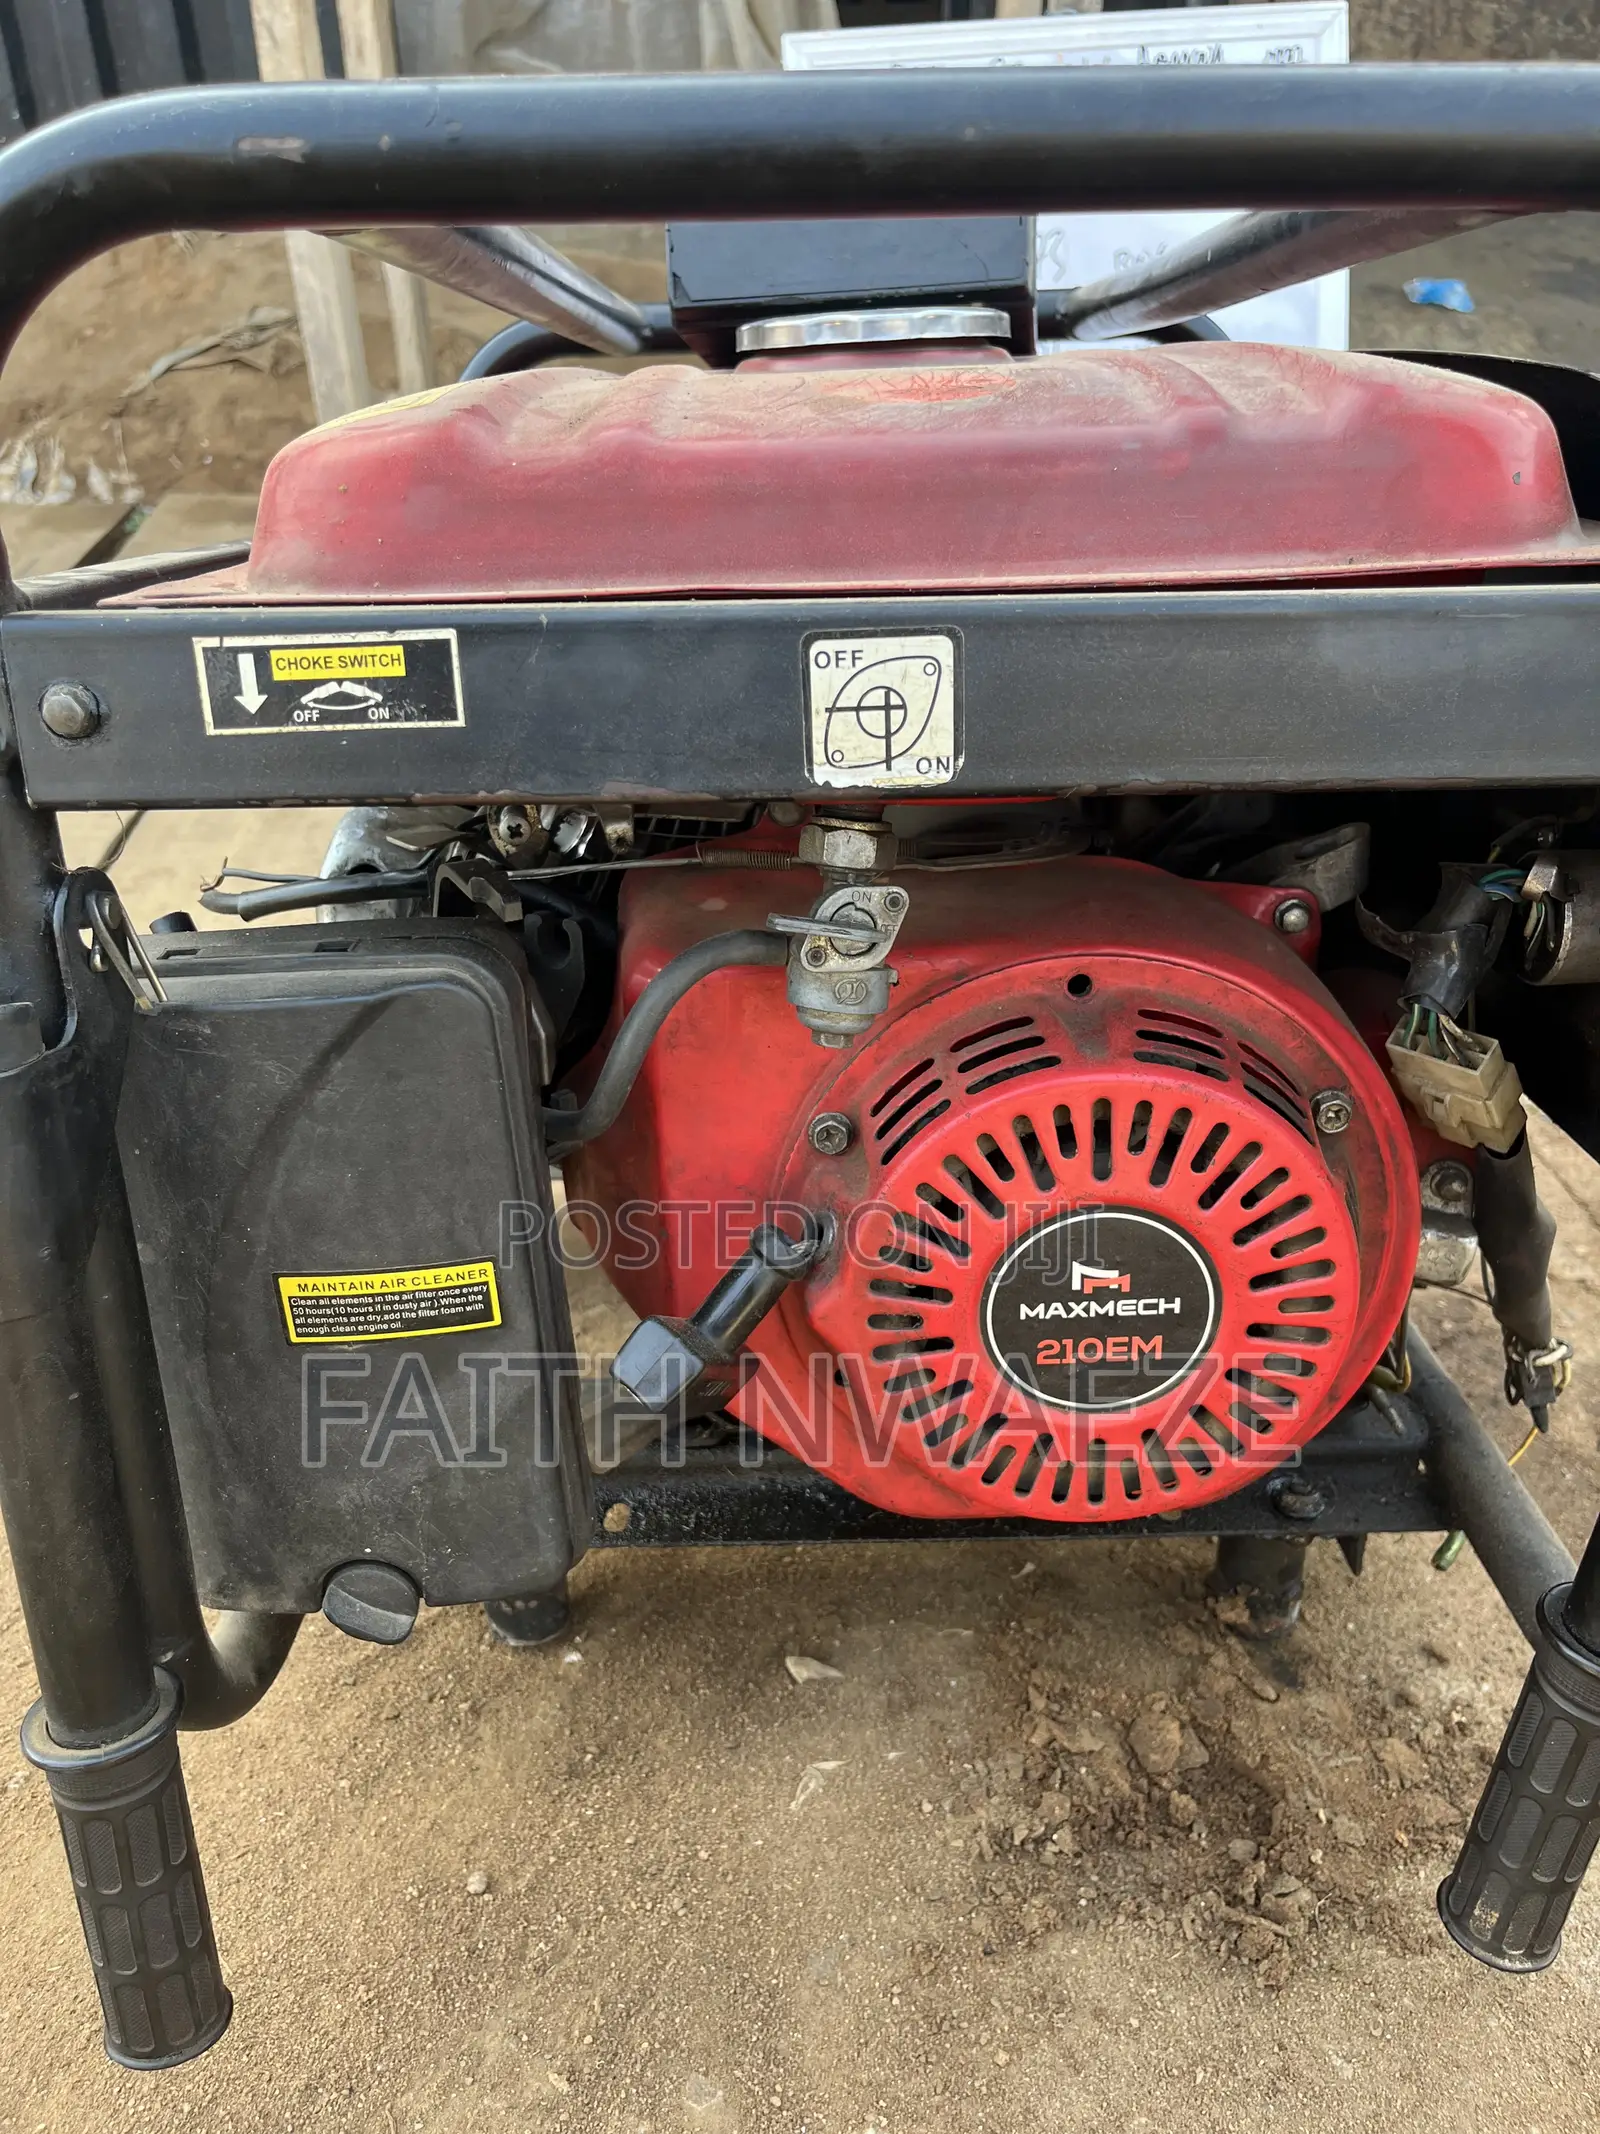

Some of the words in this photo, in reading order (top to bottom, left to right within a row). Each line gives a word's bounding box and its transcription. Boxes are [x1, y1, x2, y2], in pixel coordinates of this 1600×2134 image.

[275, 656, 334, 671] CHOKE
[338, 653, 402, 669] SWITCH
[814, 650, 864, 669] OFF
[293, 710, 320, 723] OFF
[367, 706, 390, 720] ON
[916, 756, 950, 774] ON
[851, 890, 872, 903] ON
[297, 1280, 375, 1293] MAINTAIN
[379, 1278, 406, 1289] AIR
[411, 1268, 489, 1286] CLEANER
[290, 1297, 318, 1306] Clean
[318, 1296, 330, 1305] all
[331, 1294, 373, 1305] elements
[374, 1294, 384, 1303] in
[384, 1292, 400, 1302] the
[401, 1291, 414, 1301] air
[415, 1289, 437, 1299] filter
[438, 1287, 461, 1298] once
[462, 1284, 488, 1294] every
[292, 1306, 304, 1315] 50
[347, 1303, 373, 1313] hours
[375, 1303, 382, 1312] if
[382, 1302, 392, 1311] in
[393, 1300, 418, 1311] dusty
[419, 1299, 432, 1308] air
[467, 1294, 484, 1303] the
[294, 1316, 306, 1325] all
[306, 1314, 349, 1325] elements
[349, 1314, 365, 1323] are
[402, 1308, 417, 1319] the
[418, 1307, 440, 1318] filter
[440, 1305, 465, 1315] foam
[465, 1303, 485, 1312] with
[1019, 1297, 1181, 1321] MAXMECH
[296, 1324, 330, 1335] enough
[331, 1322, 357, 1333] clean
[357, 1321, 389, 1332] engine
[390, 1321, 404, 1329] oil.
[1036, 1335, 1163, 1365] 210EM
